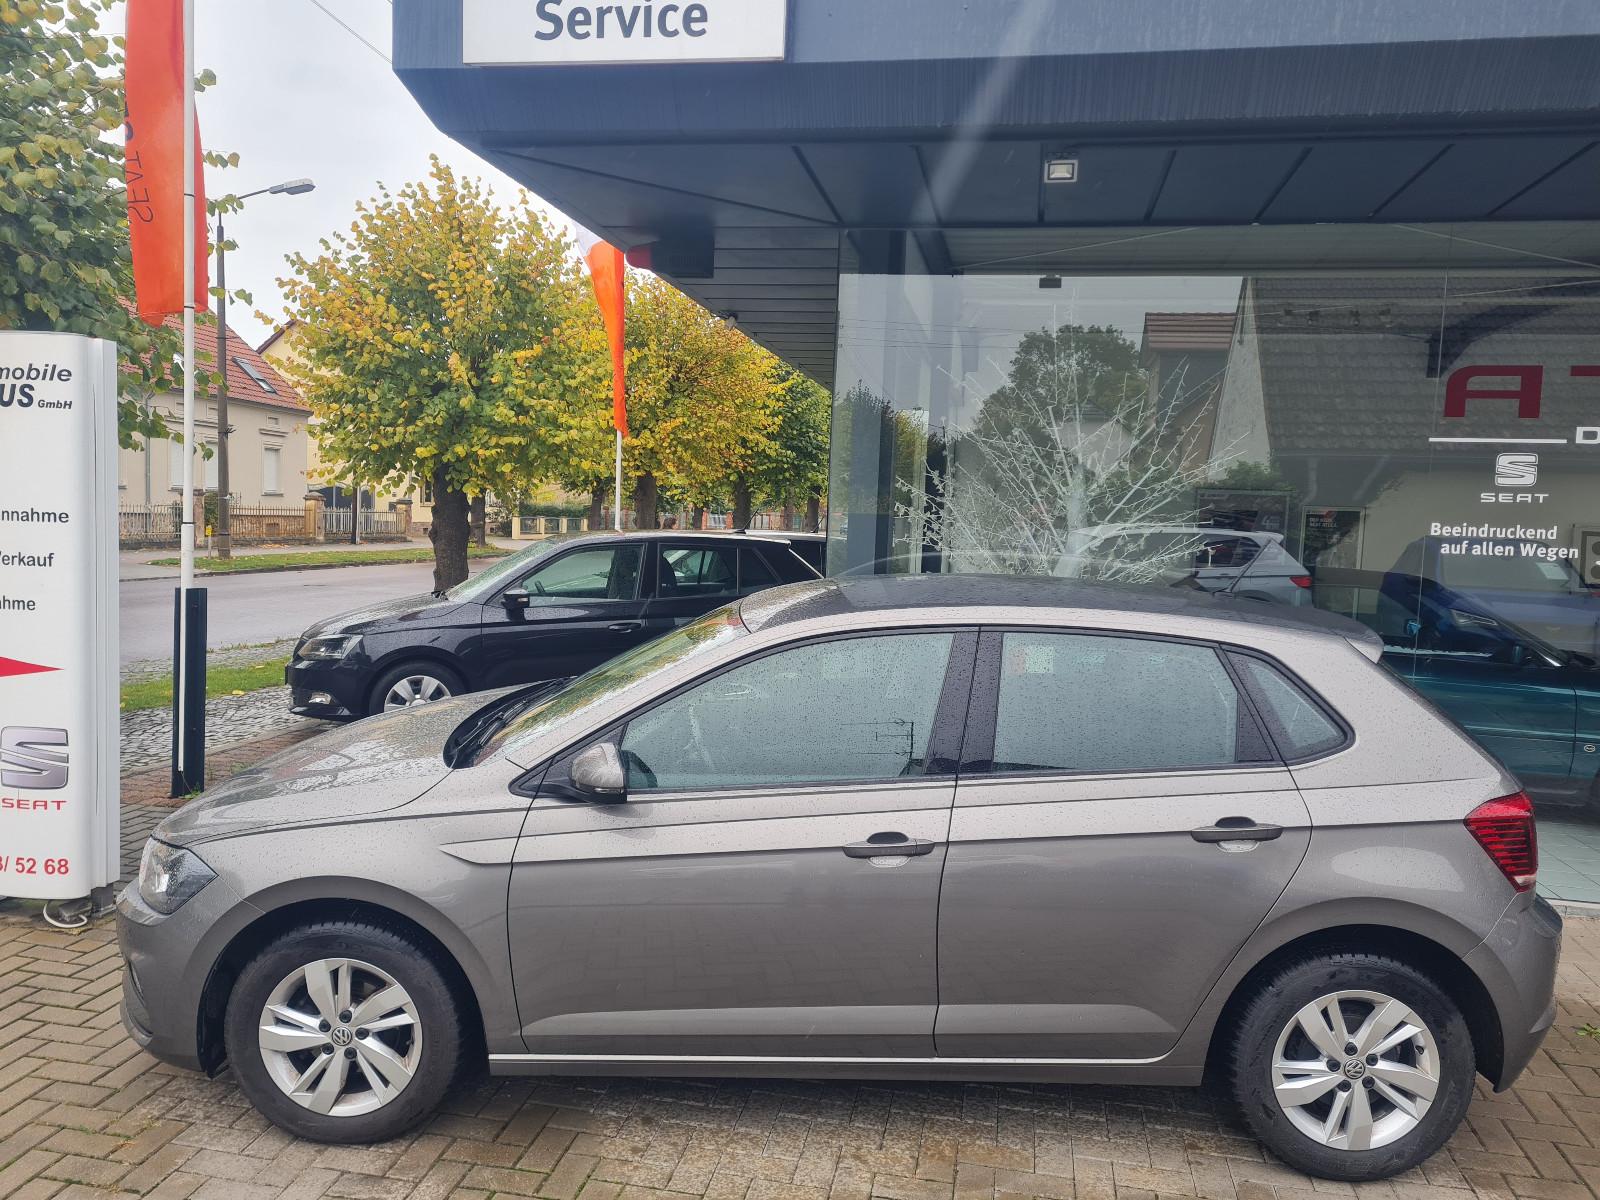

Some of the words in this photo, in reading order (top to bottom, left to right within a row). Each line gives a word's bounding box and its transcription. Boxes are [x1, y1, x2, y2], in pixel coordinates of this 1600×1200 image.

[534, 0, 708, 40] Service
[0, 384, 35, 408] US
[38, 399, 73, 410] GmbH
[1480, 492, 1549, 504] SEAT
[1430, 522, 1558, 540] Beeindruckend
[1440, 541, 1469, 555] auf
[1471, 542, 1515, 557] allen
[1520, 543, 1579, 561] Wegen
[1, 797, 67, 811] SEAT
[16, 857, 37, 875] 52
[44, 858, 69, 875] 68
